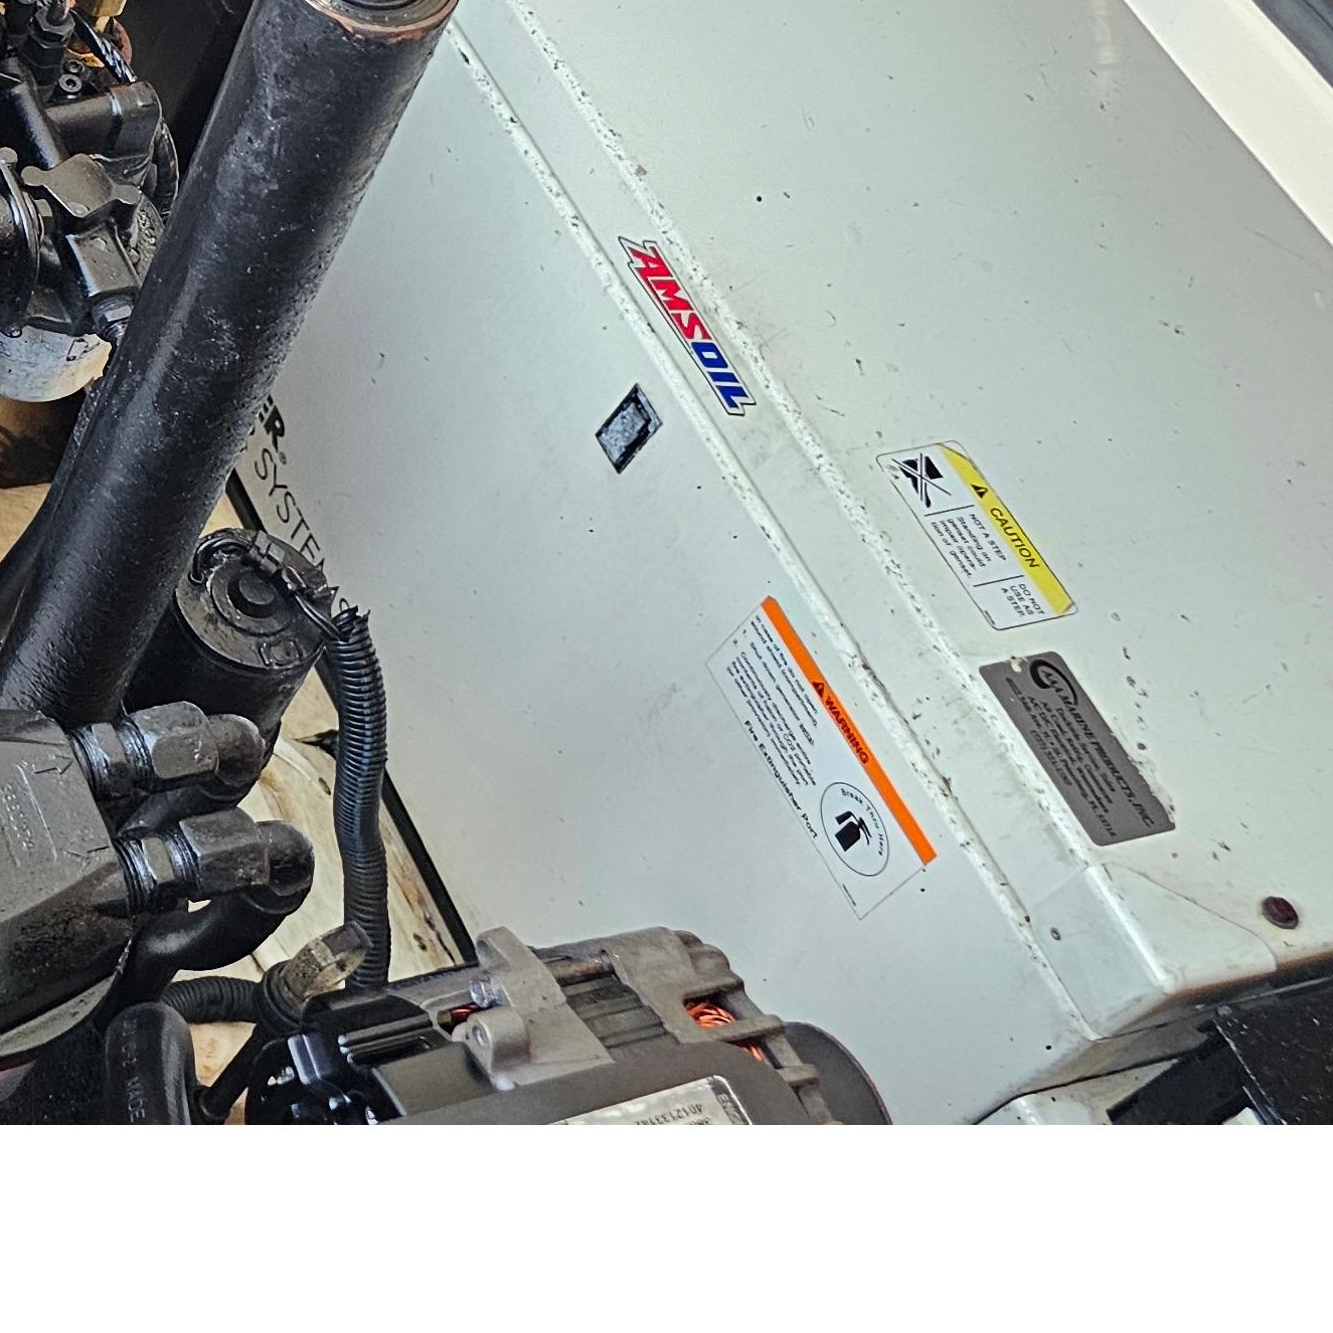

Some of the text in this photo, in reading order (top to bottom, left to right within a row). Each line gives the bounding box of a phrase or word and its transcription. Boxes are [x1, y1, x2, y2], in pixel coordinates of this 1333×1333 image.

[623, 244, 753, 414] AMSOIL
[930, 521, 973, 578] tion of genset.
[939, 520, 977, 570] impair opera-
[947, 518, 986, 567] genset could
[956, 516, 991, 561] Standing on
[969, 514, 984, 530] NOT
[988, 540, 1006, 560] STEP
[988, 506, 1039, 568] CAUTION
[1009, 585, 1034, 615] USE AS
[1017, 583, 1044, 615] DO NOT
[822, 695, 870, 764] WARNING
[1041, 669, 1063, 693] AAA
[1058, 694, 1097, 741] MARINE
[743, 718, 819, 839] Fire Extinguisher Port
